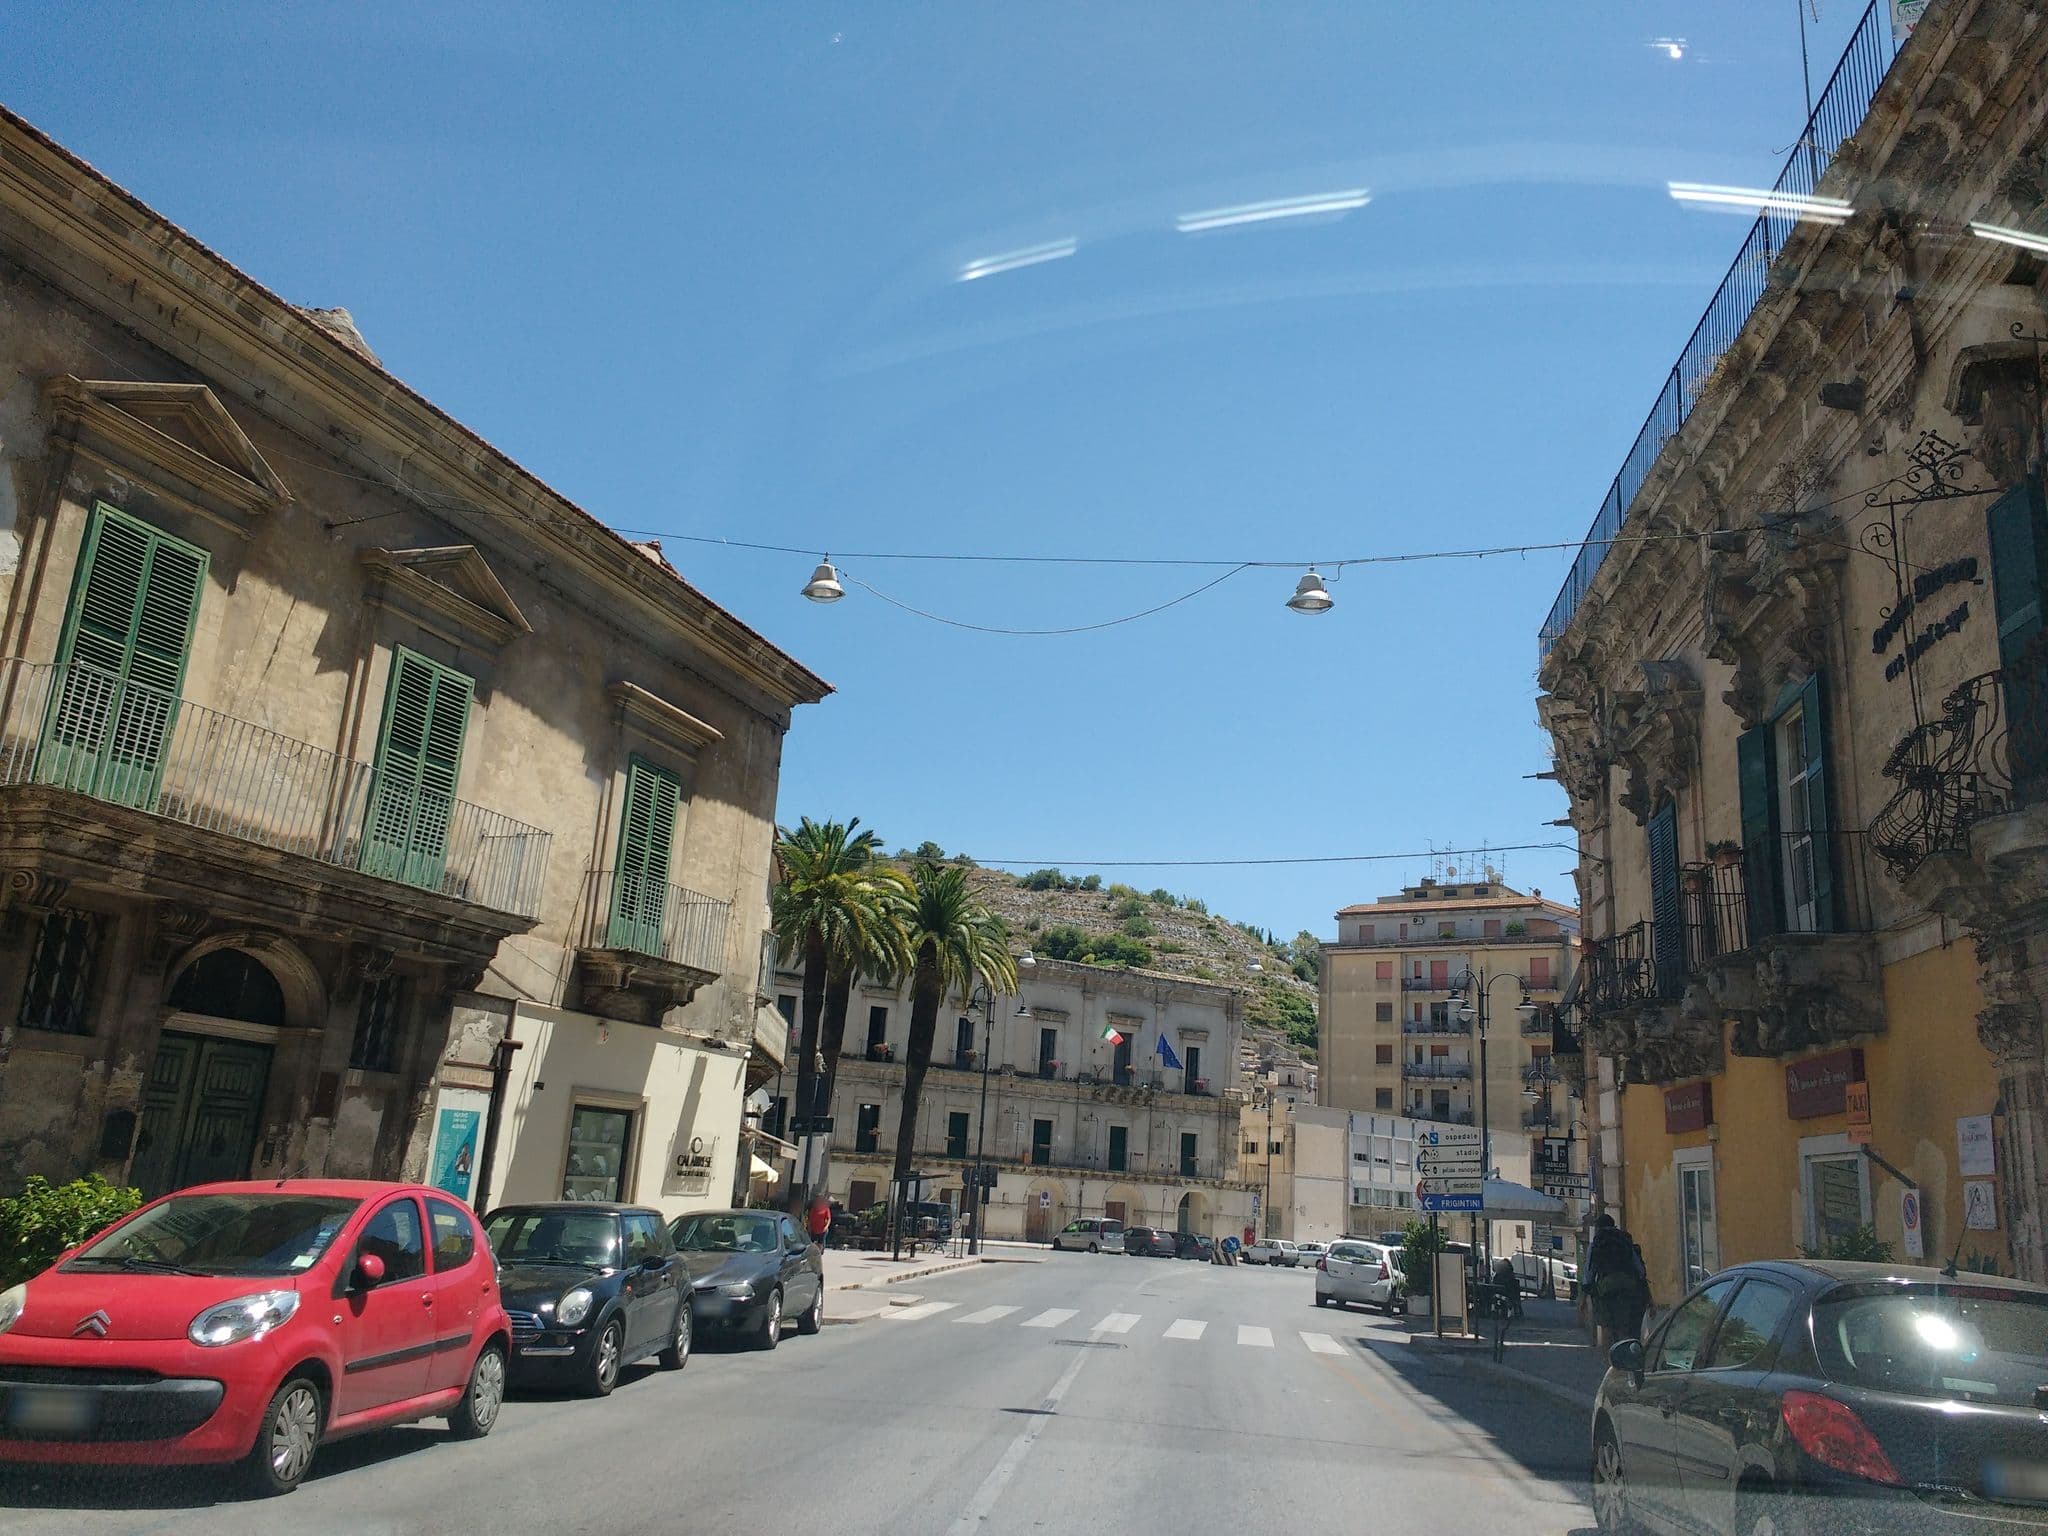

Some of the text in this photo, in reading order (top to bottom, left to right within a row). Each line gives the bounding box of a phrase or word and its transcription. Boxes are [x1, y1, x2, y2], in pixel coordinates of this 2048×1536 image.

[1445, 1133, 1478, 1141] ospedale
[1553, 1175, 1580, 1185] LOTTO
[1549, 1187, 1575, 1197] BAR
[1441, 1199, 1480, 1208] FRIGINTINI
[1918, 1482, 1963, 1492] PEUGEOT
